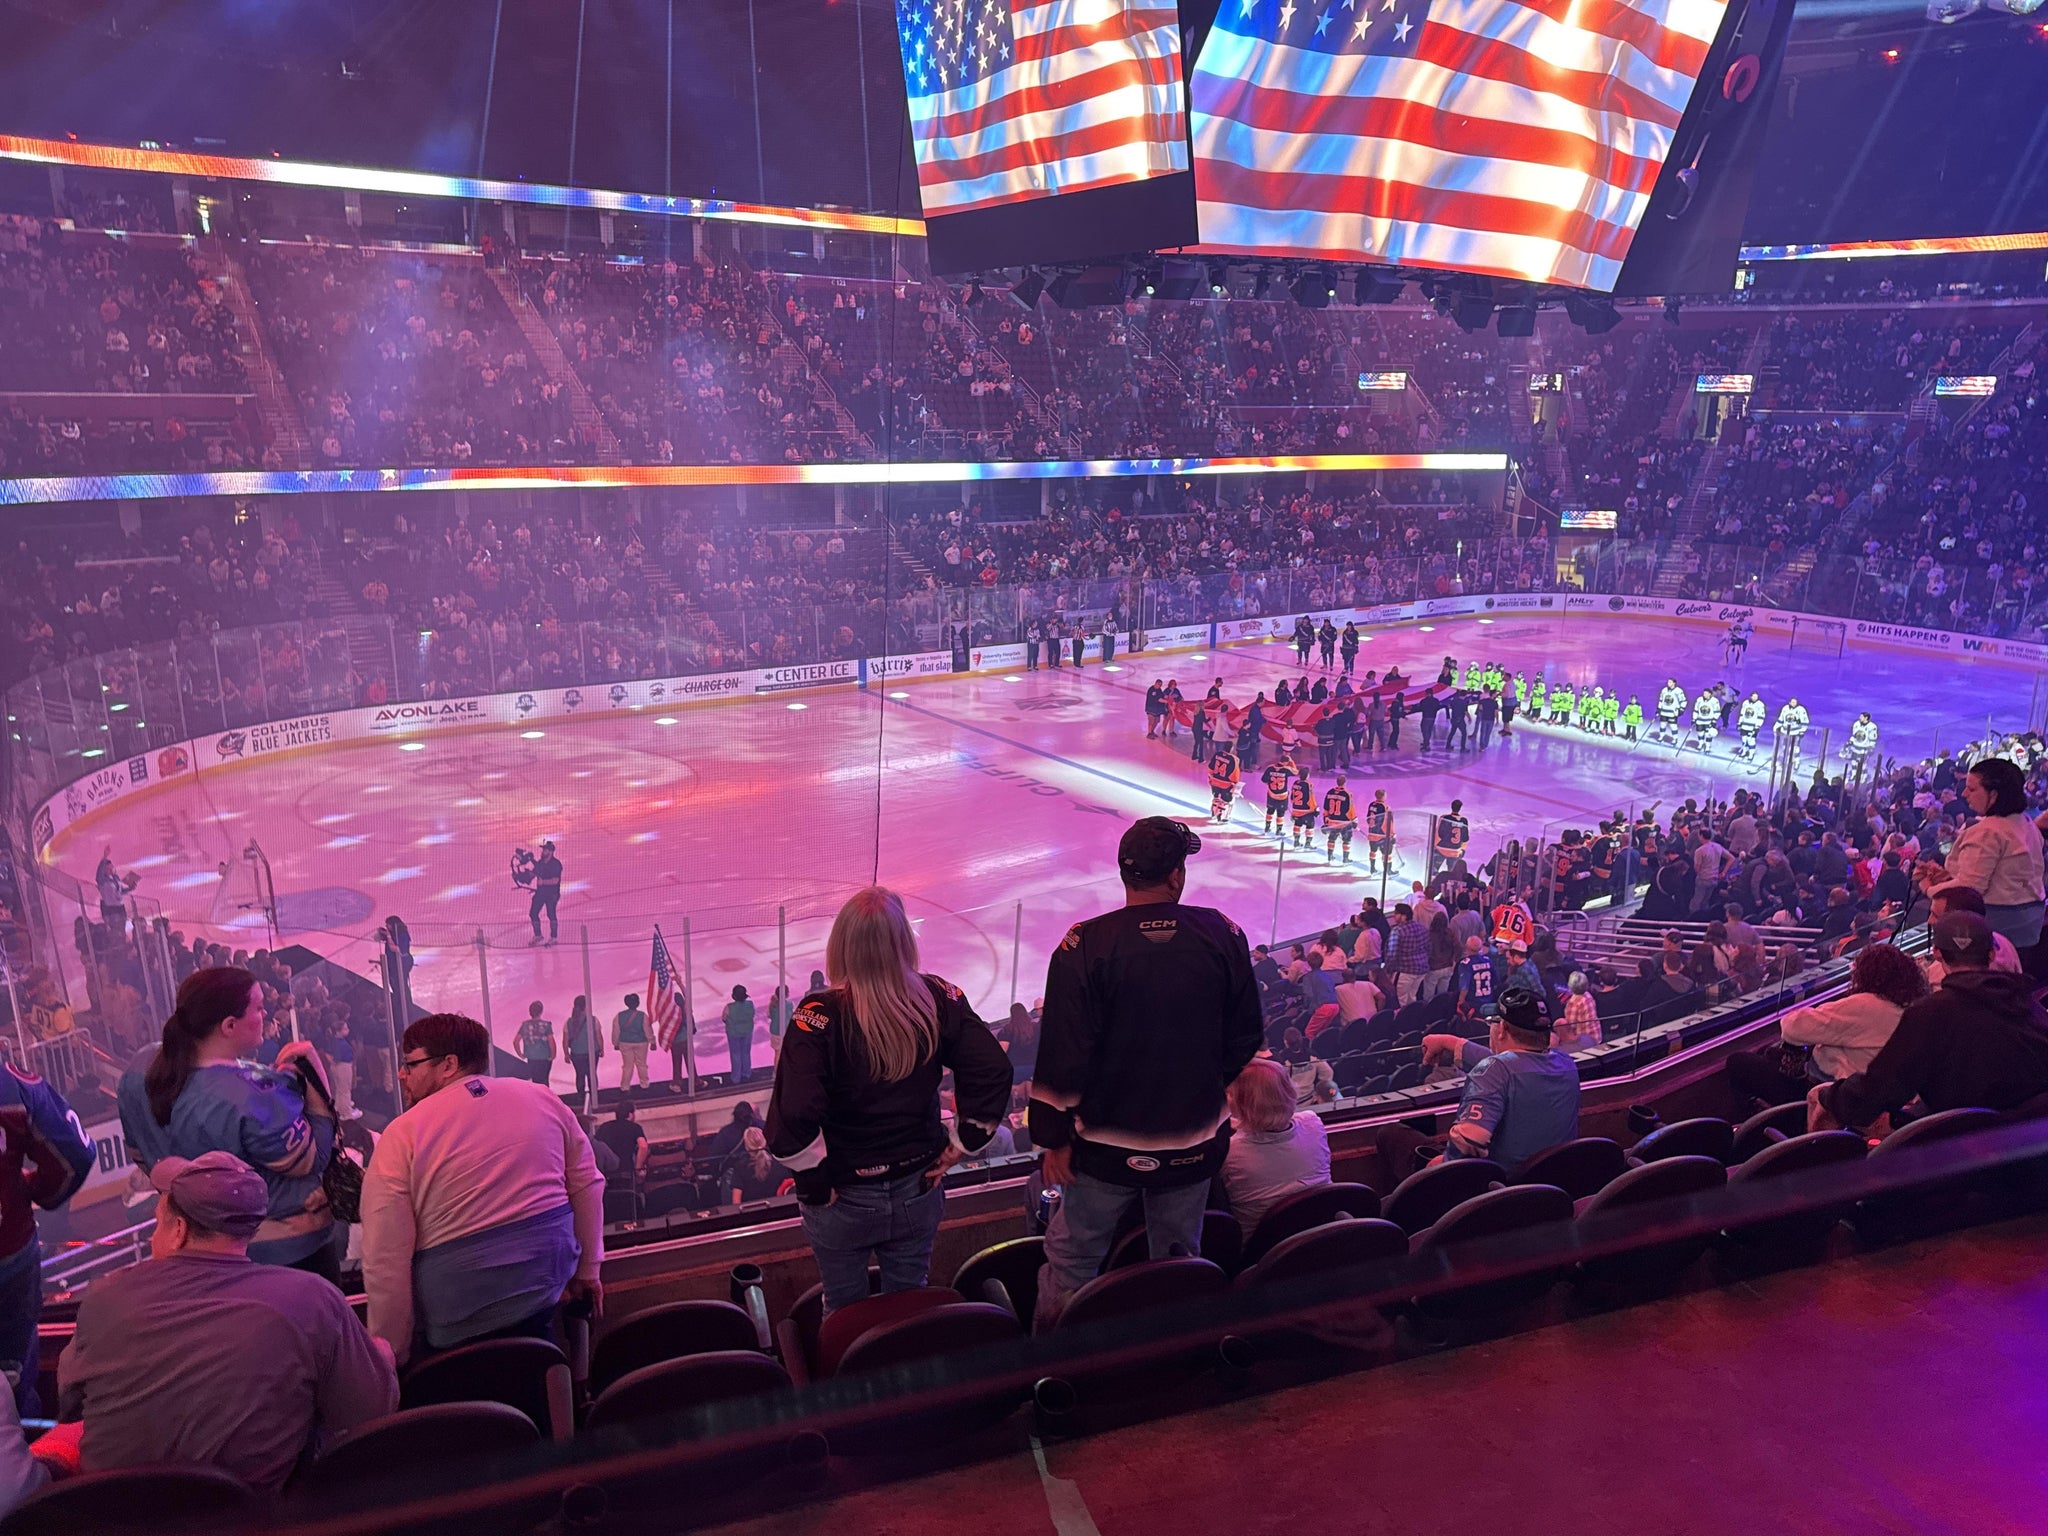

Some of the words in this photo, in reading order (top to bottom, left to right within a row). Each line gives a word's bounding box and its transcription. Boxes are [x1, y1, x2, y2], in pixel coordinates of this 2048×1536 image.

[1675, 602, 1712, 616] Culver's
[1868, 624, 1892, 636] HITS
[1893, 627, 1938, 642] HAPPEN
[775, 665, 827, 683] CENTER
[830, 663, 850, 678] ICE
[375, 701, 479, 721] AVONLAKE
[251, 716, 330, 738] COLUMBUS
[252, 735, 281, 753] BLUE
[284, 726, 332, 747] JACKETS
[1450, 827, 1461, 844] 3
[1139, 919, 1178, 930] CCM
[1500, 910, 1526, 934] 16
[1473, 971, 1492, 997] 13
